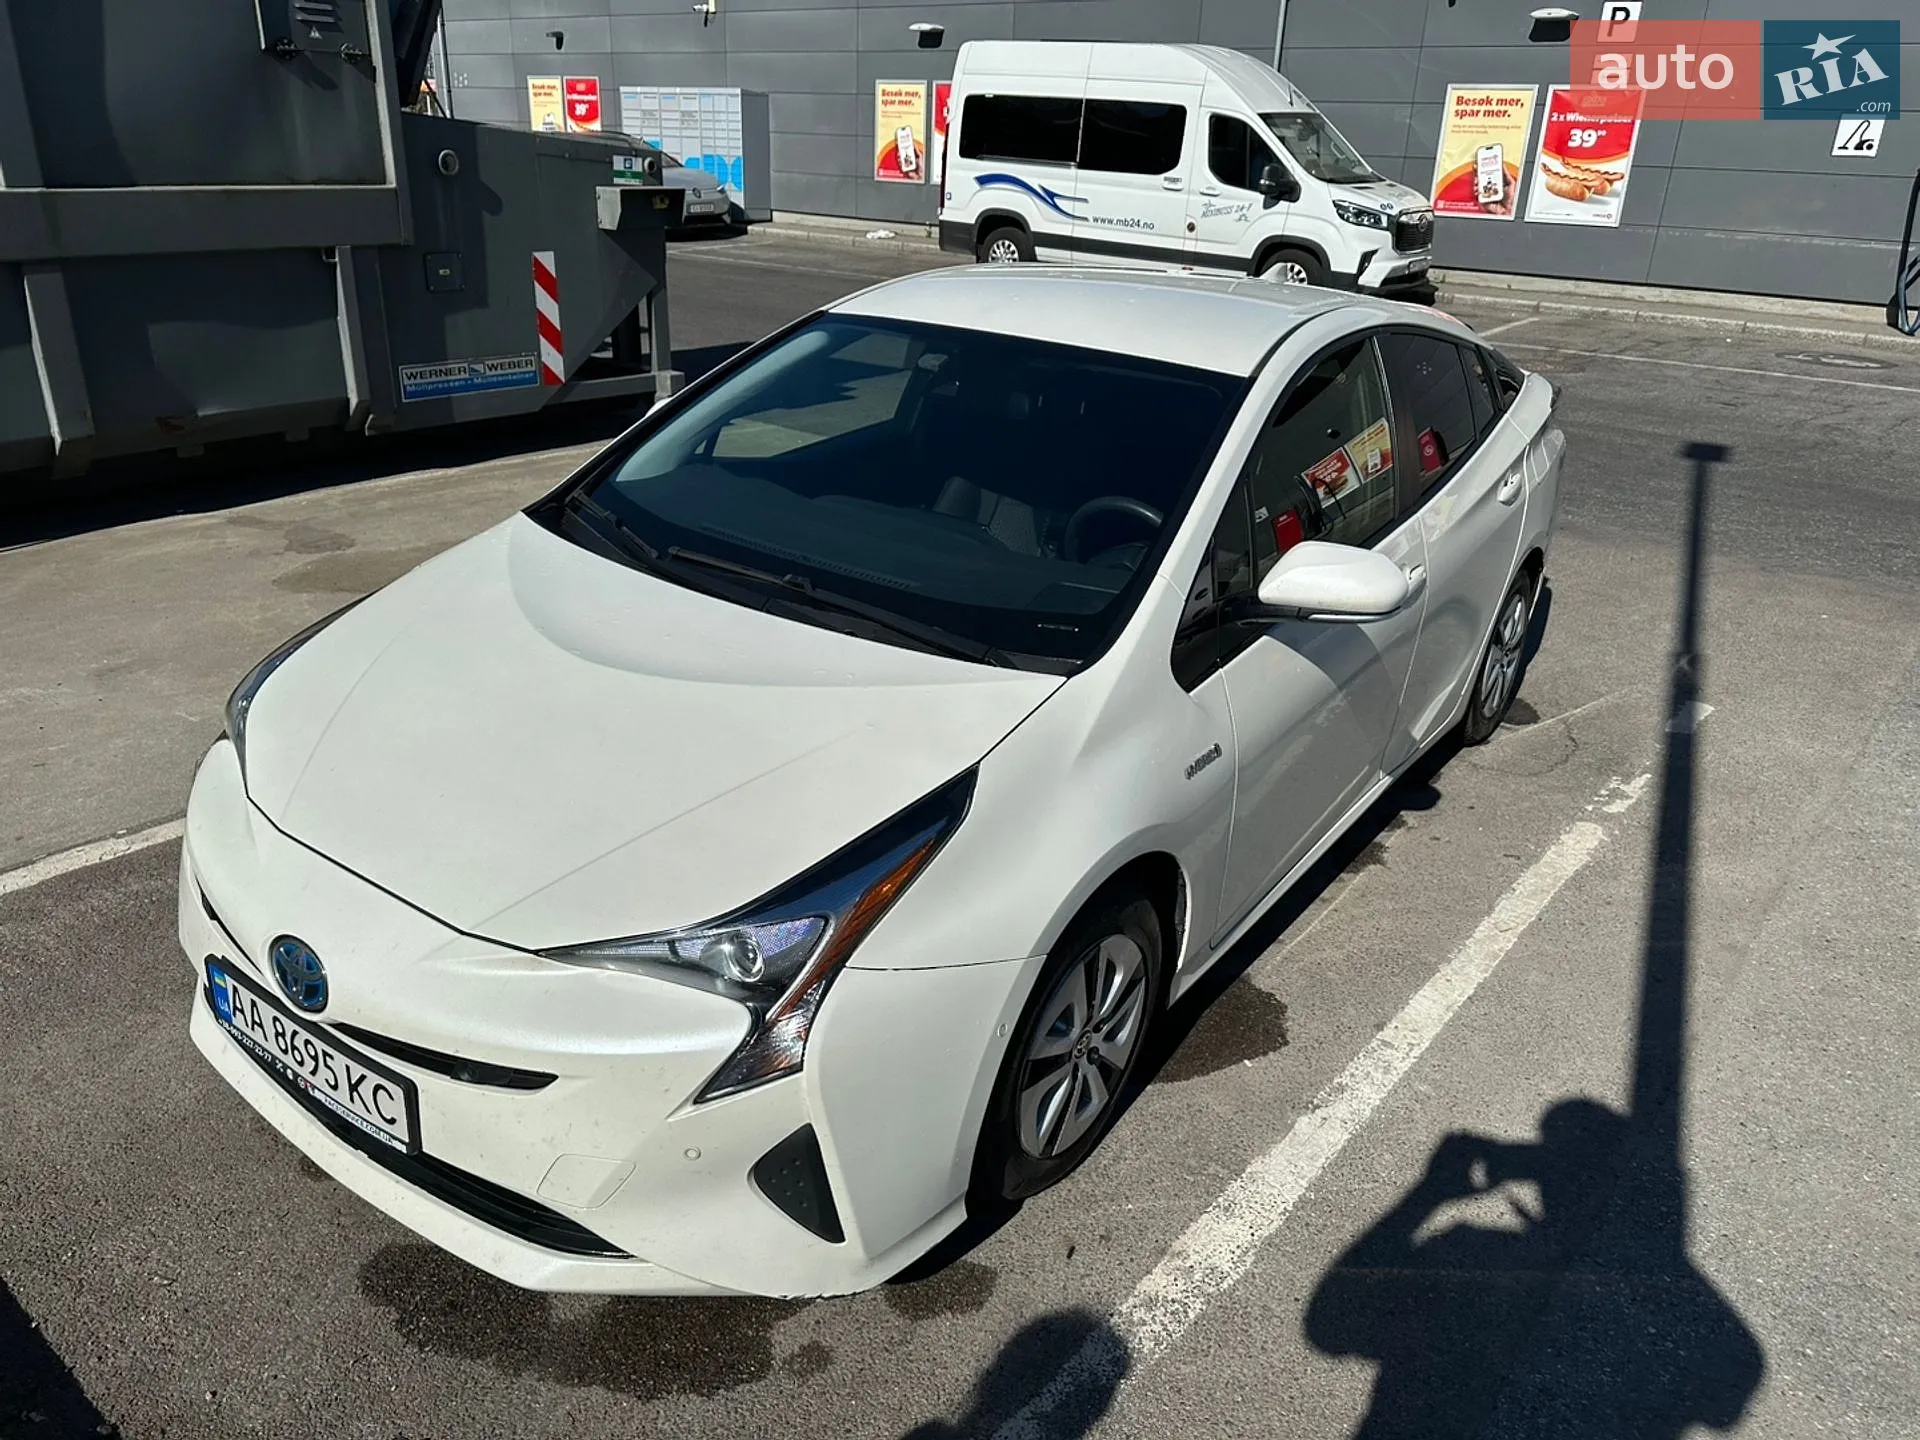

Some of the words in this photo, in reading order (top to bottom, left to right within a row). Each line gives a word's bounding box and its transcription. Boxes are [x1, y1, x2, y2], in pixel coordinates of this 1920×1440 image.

[1606, 6, 1631, 37] P
[1495, 97, 1524, 109] mer,
[1454, 108, 1481, 120] spar
[1483, 109, 1511, 118] mer.
[1092, 215, 1155, 230] www.mb24.no
[404, 365, 467, 381] WERNER
[486, 359, 534, 372] WEBER
[232, 983, 268, 1043] AA
[272, 1014, 339, 1091] 8695
[345, 1063, 397, 1126] KC
